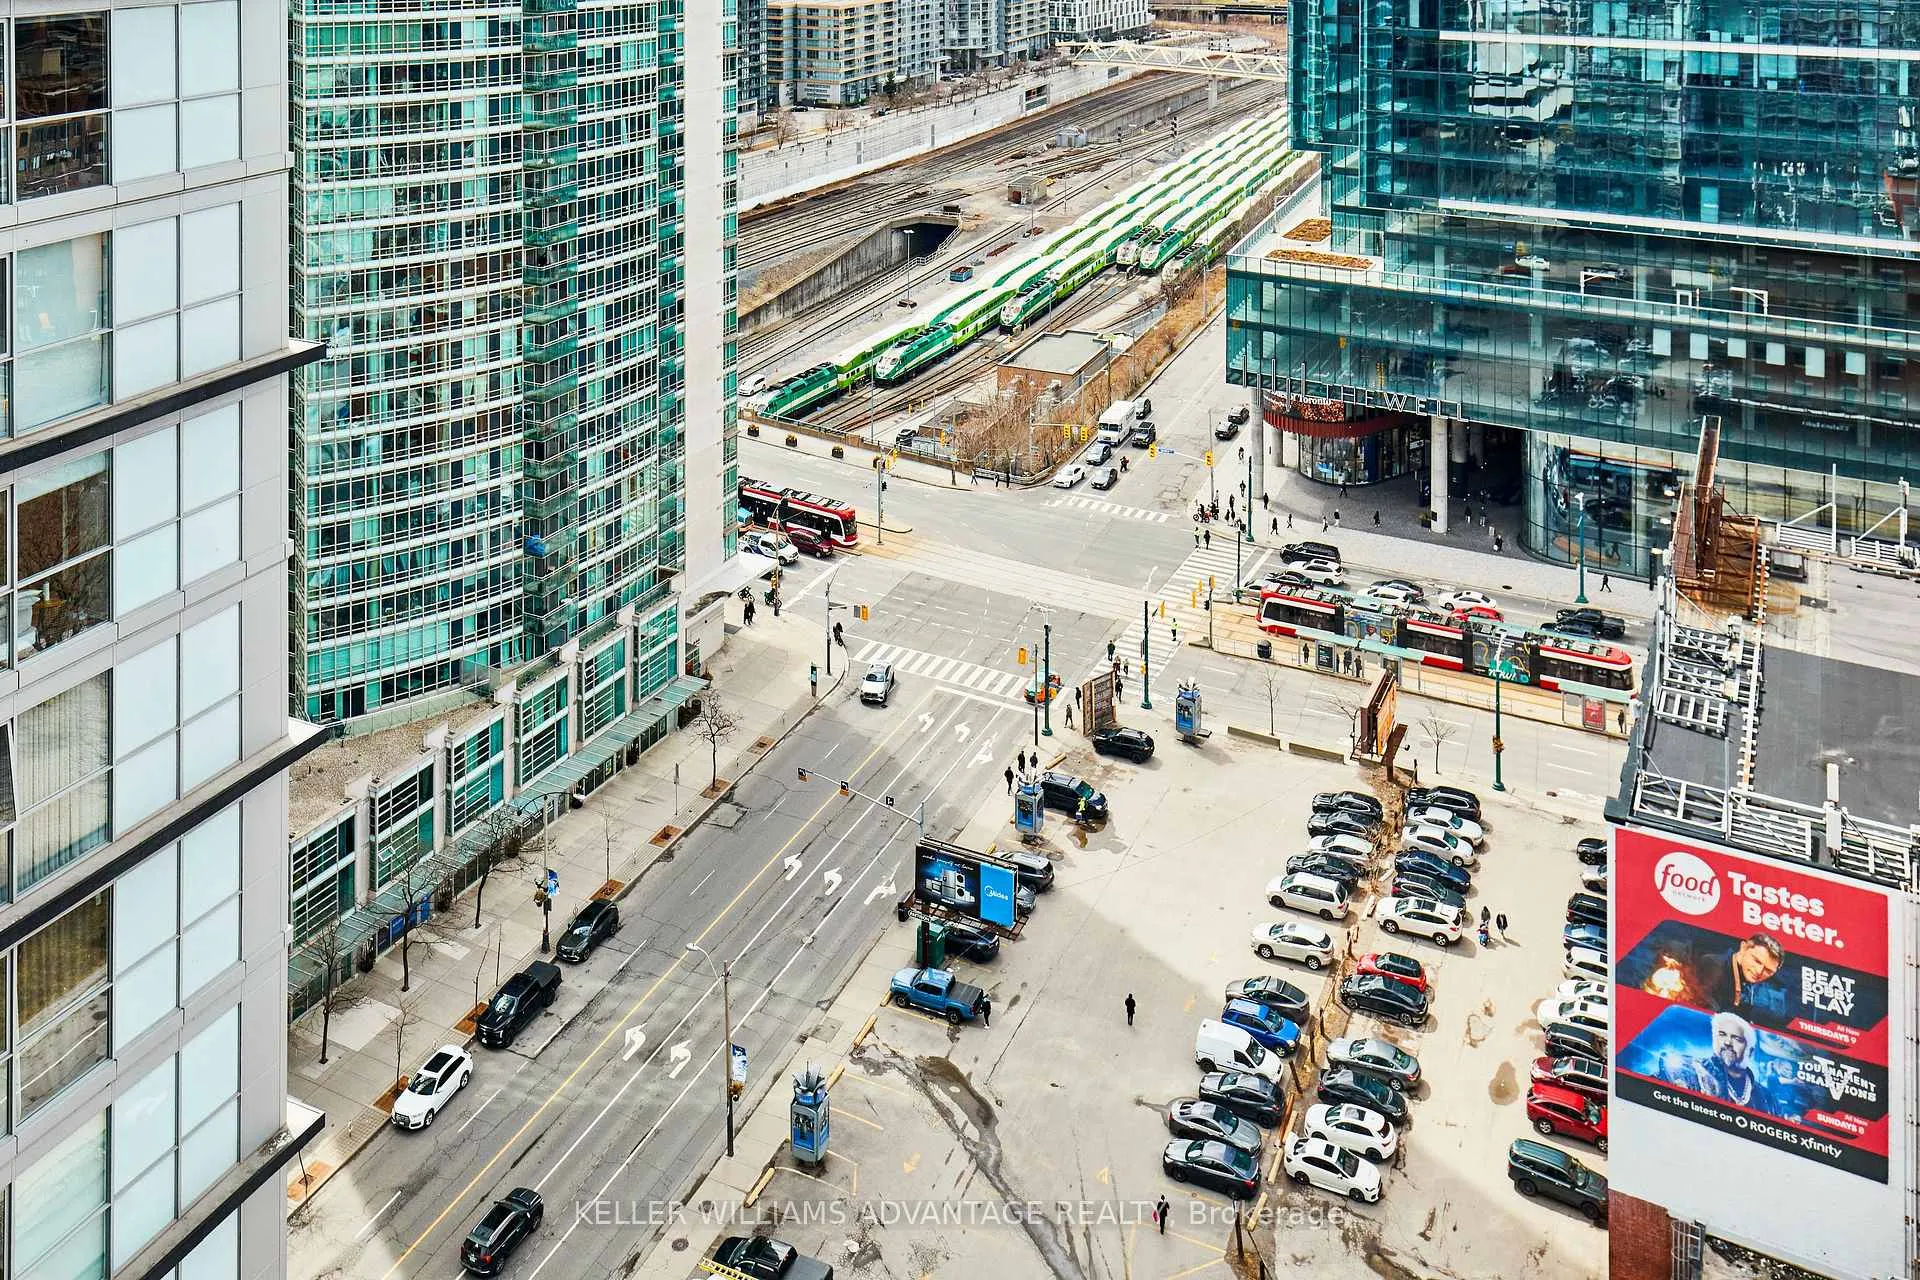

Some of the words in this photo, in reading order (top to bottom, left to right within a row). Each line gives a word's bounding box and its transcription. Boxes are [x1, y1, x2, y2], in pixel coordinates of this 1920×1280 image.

[1299, 392, 1332, 405] Toronto
[1324, 383, 1375, 408] THE
[1383, 391, 1469, 422] WELL
[1660, 864, 1716, 896] food
[1728, 871, 1824, 917] Tastes
[1743, 900, 1844, 949] Better.
[1802, 966, 1855, 992] BEAT
[1802, 979, 1855, 1003] BOBBY
[1802, 990, 1854, 1016] FLAY
[1653, 1090, 1671, 1103] Get
[1673, 1095, 1689, 1108] the
[1691, 1101, 1718, 1118] latest
[1720, 1112, 1732, 1122] on
[1750, 1121, 1798, 1144] ROGERS
[1800, 1136, 1842, 1159] xfinity
[1817, 1113, 1857, 1133] SUNDAYS
